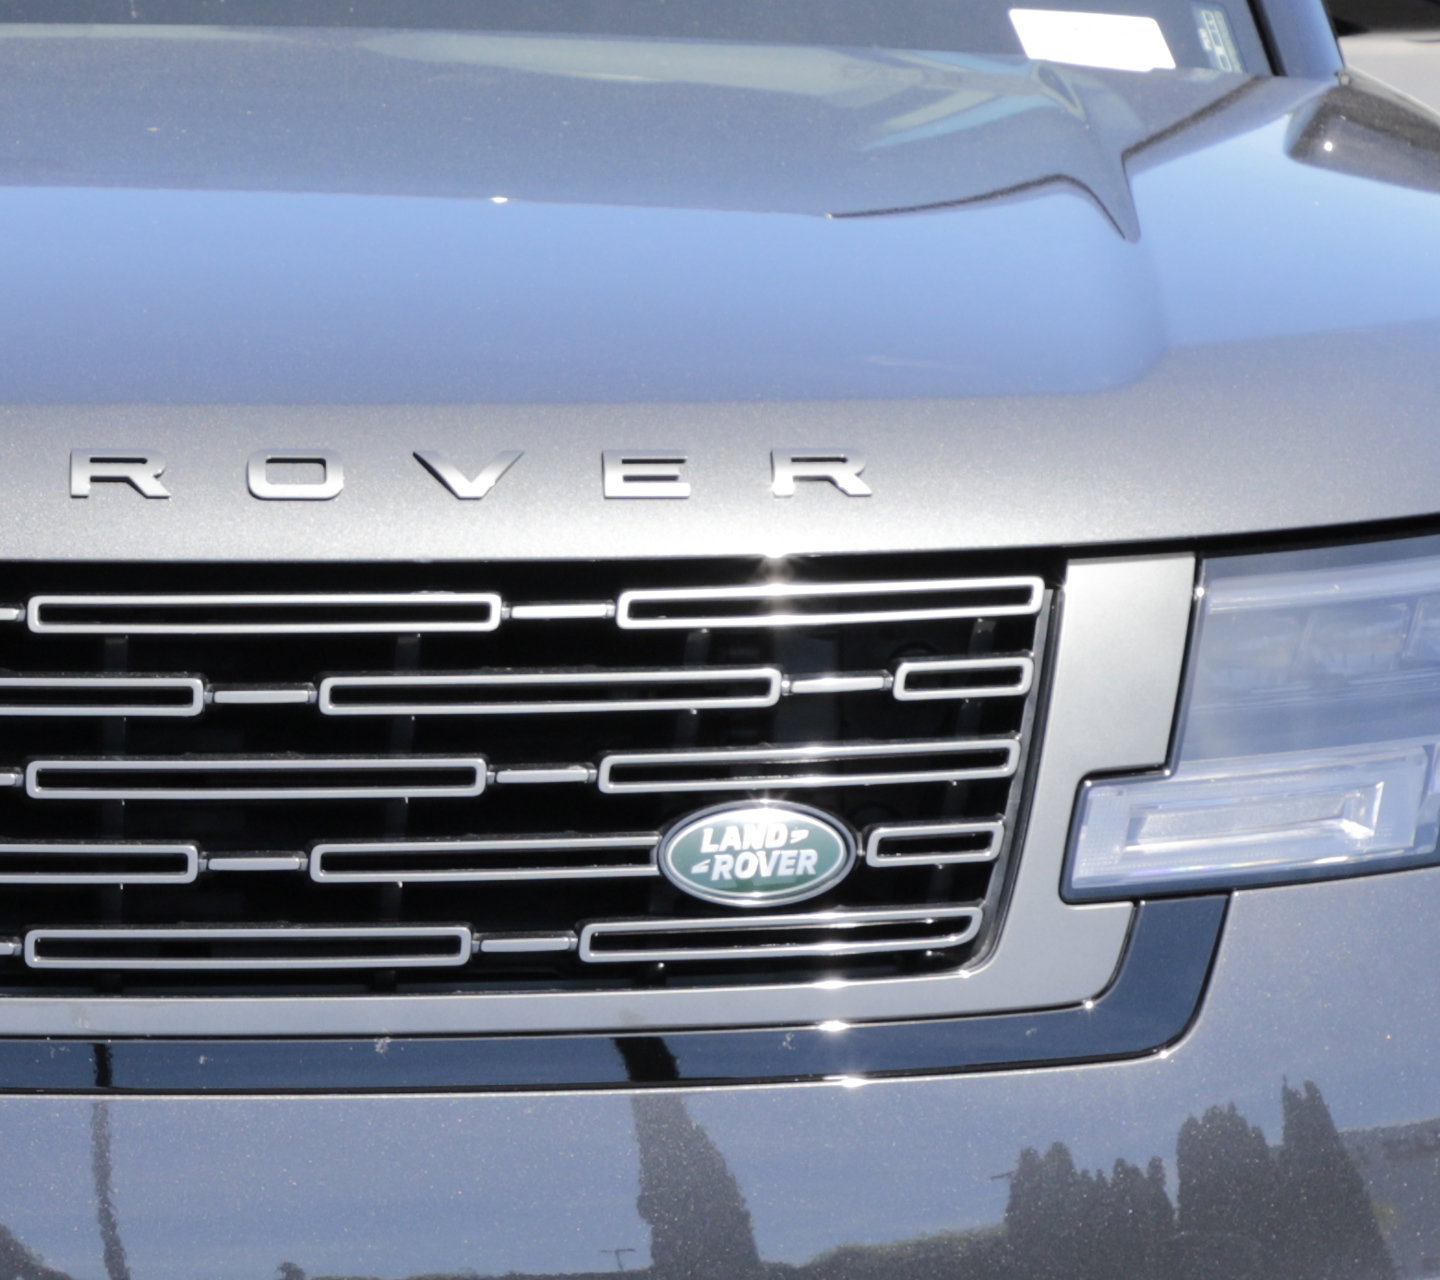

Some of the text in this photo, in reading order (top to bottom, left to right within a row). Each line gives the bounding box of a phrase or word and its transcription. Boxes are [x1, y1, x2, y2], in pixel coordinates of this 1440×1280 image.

[70, 448, 872, 500] ROVER
[700, 823, 788, 853] LAND
[711, 849, 818, 881] ROVER
